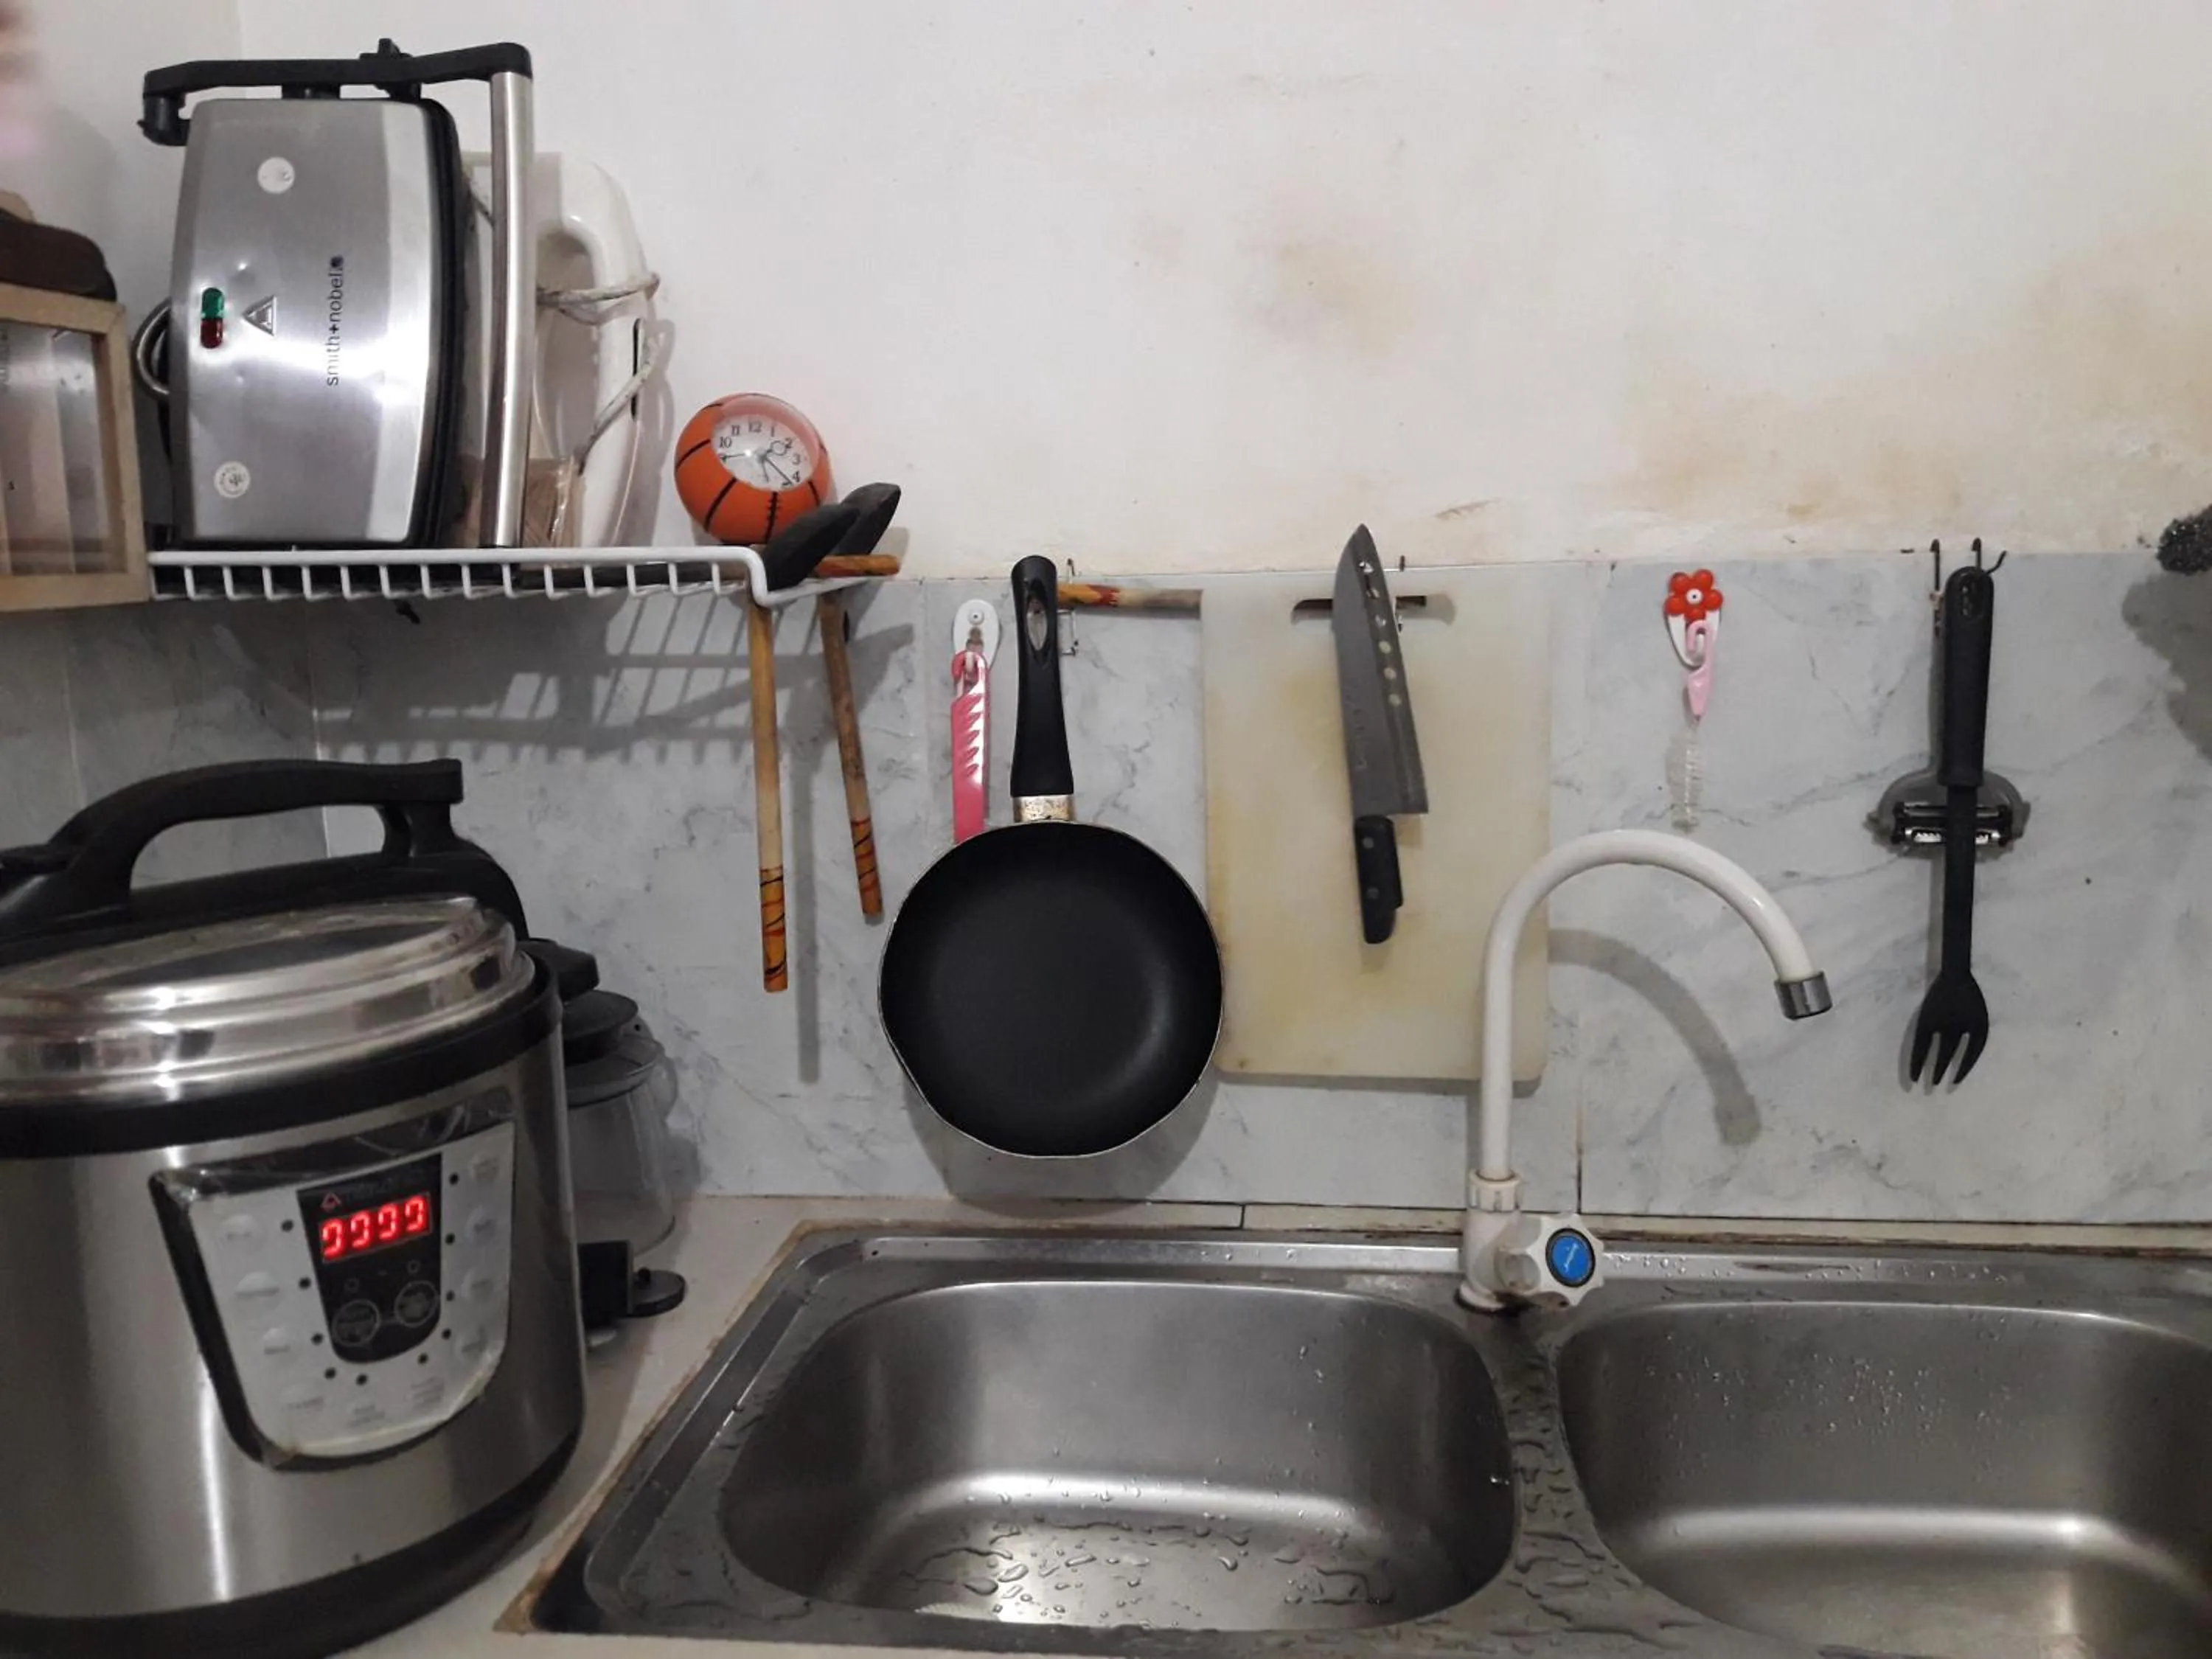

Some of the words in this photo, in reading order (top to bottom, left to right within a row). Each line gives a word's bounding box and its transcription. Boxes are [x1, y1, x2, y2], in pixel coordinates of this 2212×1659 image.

[731, 424, 740, 436] 11
[748, 420, 762, 434] 12
[720, 437, 732, 448] 10
[785, 437, 793, 449] 2
[792, 453, 801, 465] 3
[793, 470, 800, 483] 4
